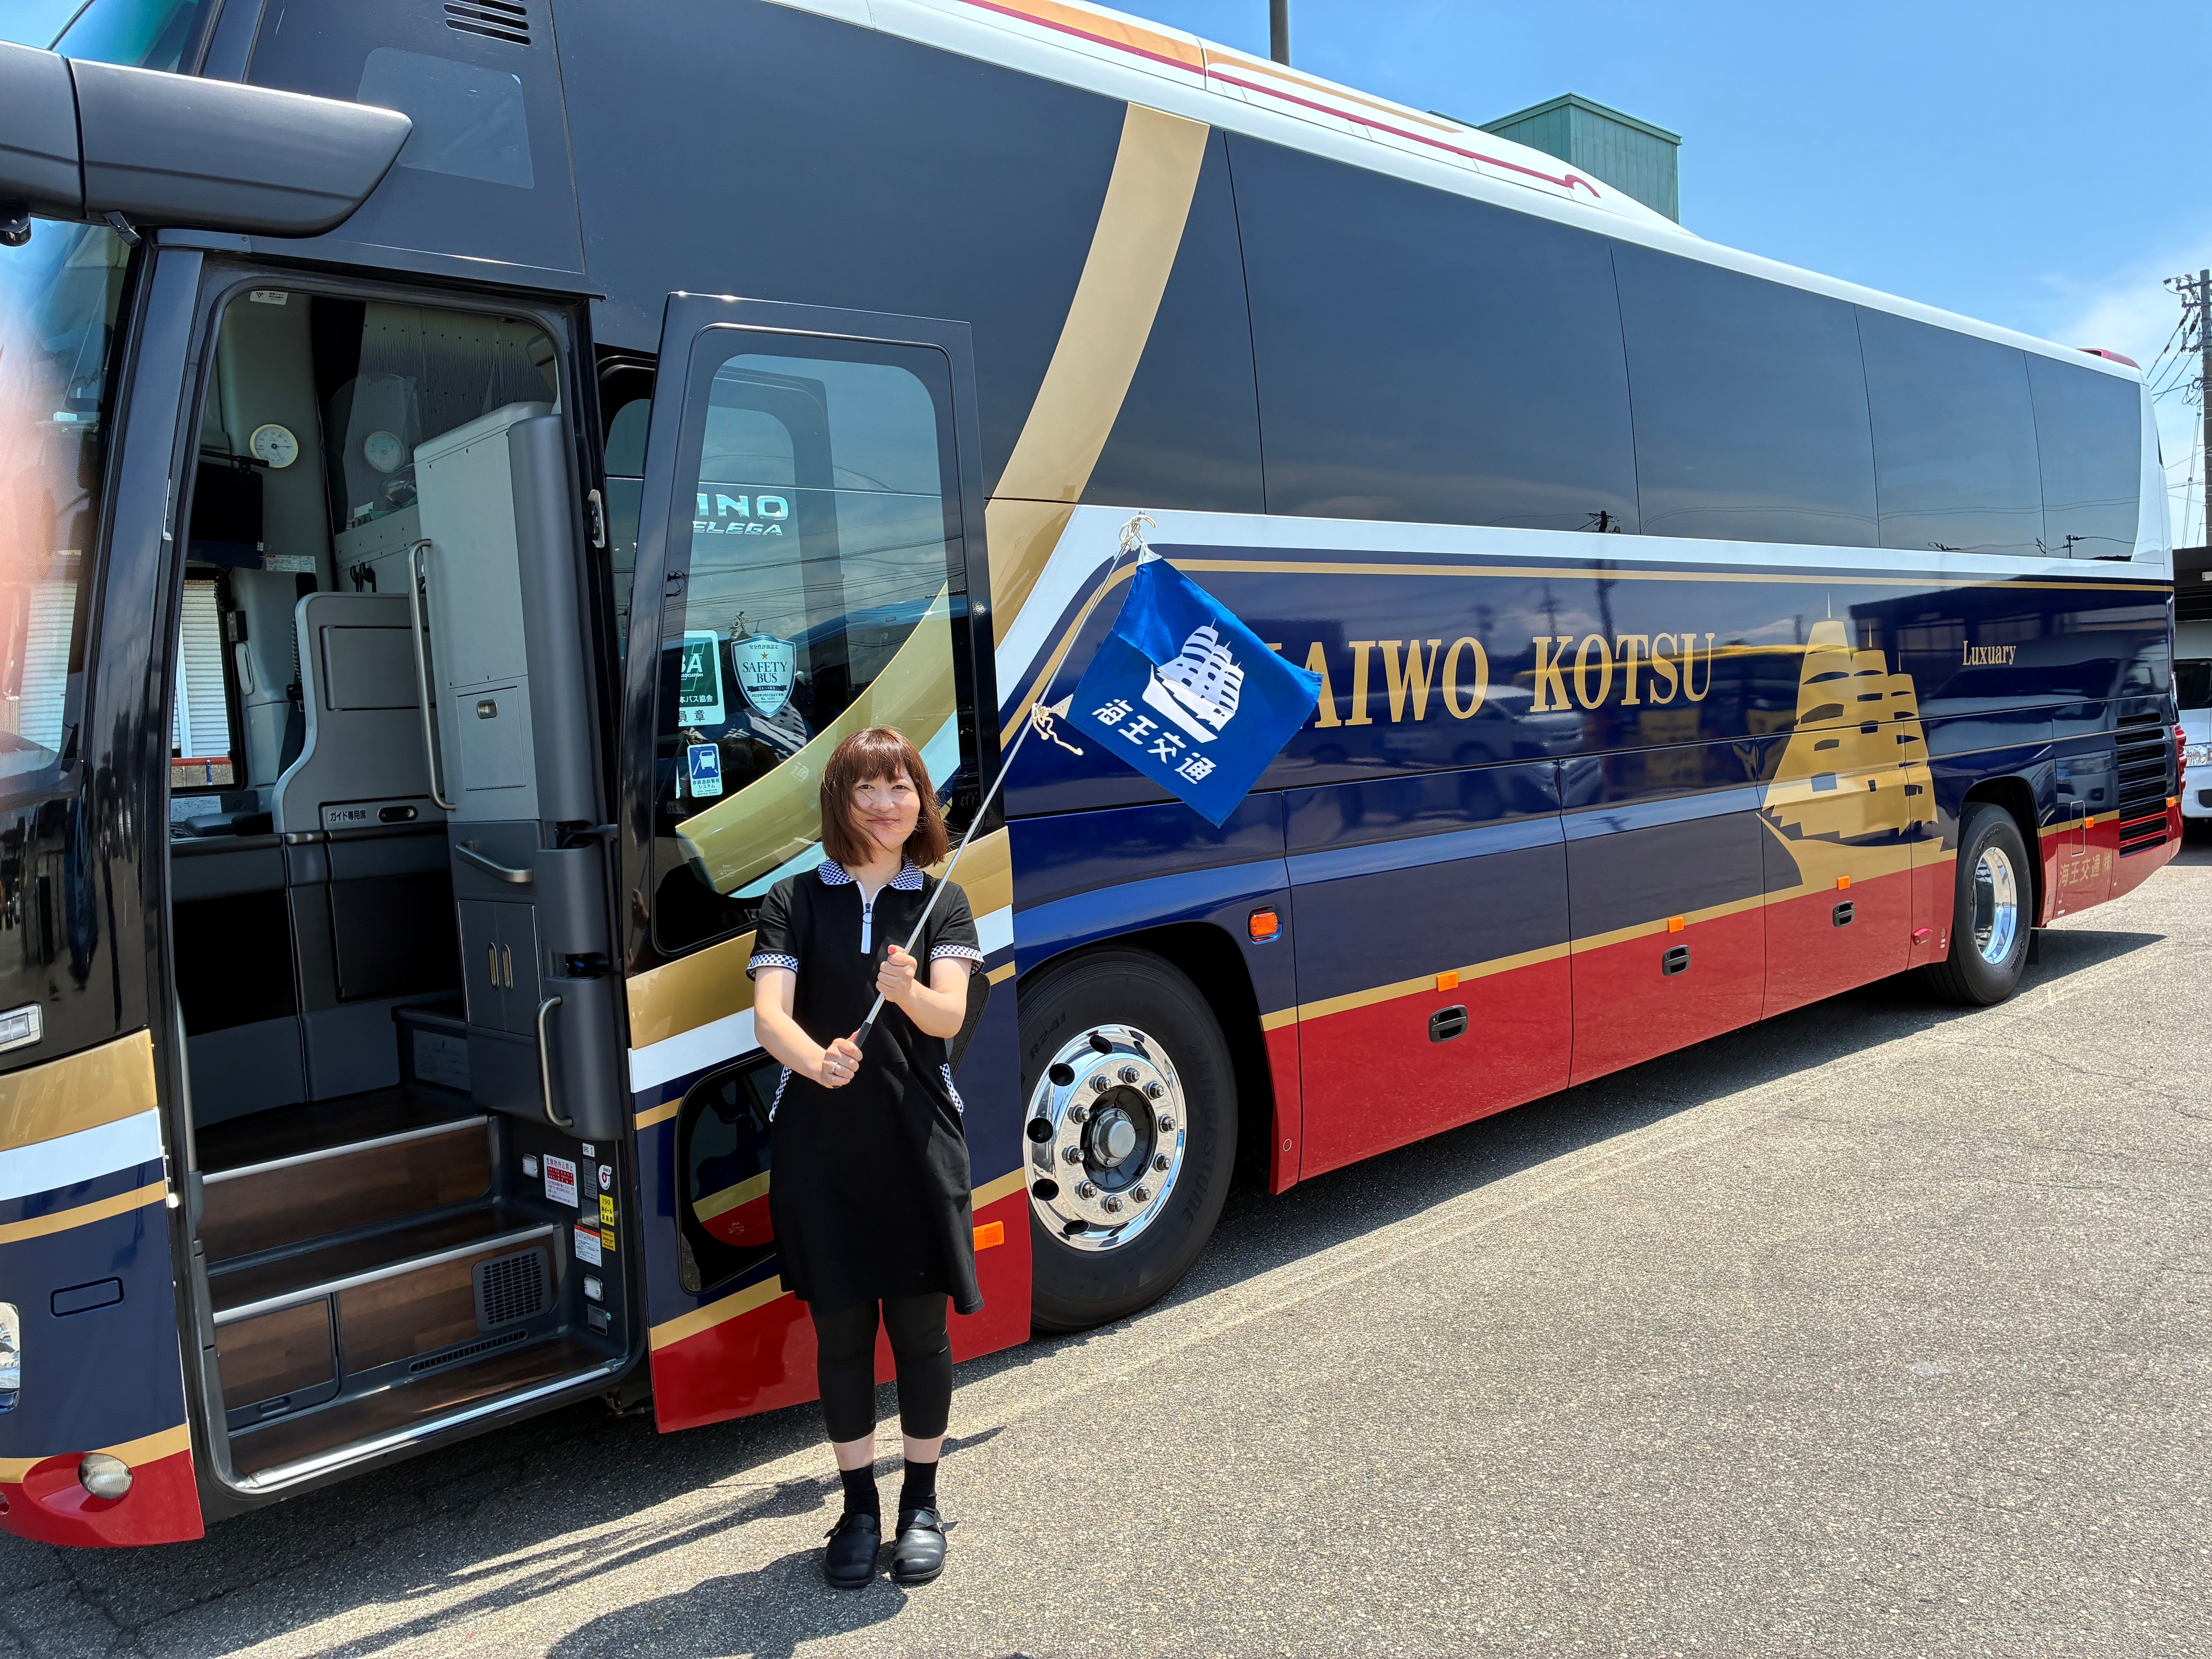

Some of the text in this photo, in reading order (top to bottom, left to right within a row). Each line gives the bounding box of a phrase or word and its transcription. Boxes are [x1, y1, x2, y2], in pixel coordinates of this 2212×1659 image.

[697, 493, 788, 520] INO
[692, 521, 783, 536] ELEGA
[1962, 640, 2017, 666] Luxuary
[742, 661, 787, 673] SAFETY
[756, 673, 778, 683] BUS
[1266, 632, 1716, 729] AIWO KOTSU
[1092, 698, 1217, 785] 海王交通
[330, 810, 366, 822] ガイド専用席
[602, 1197, 610, 1206] ISO
